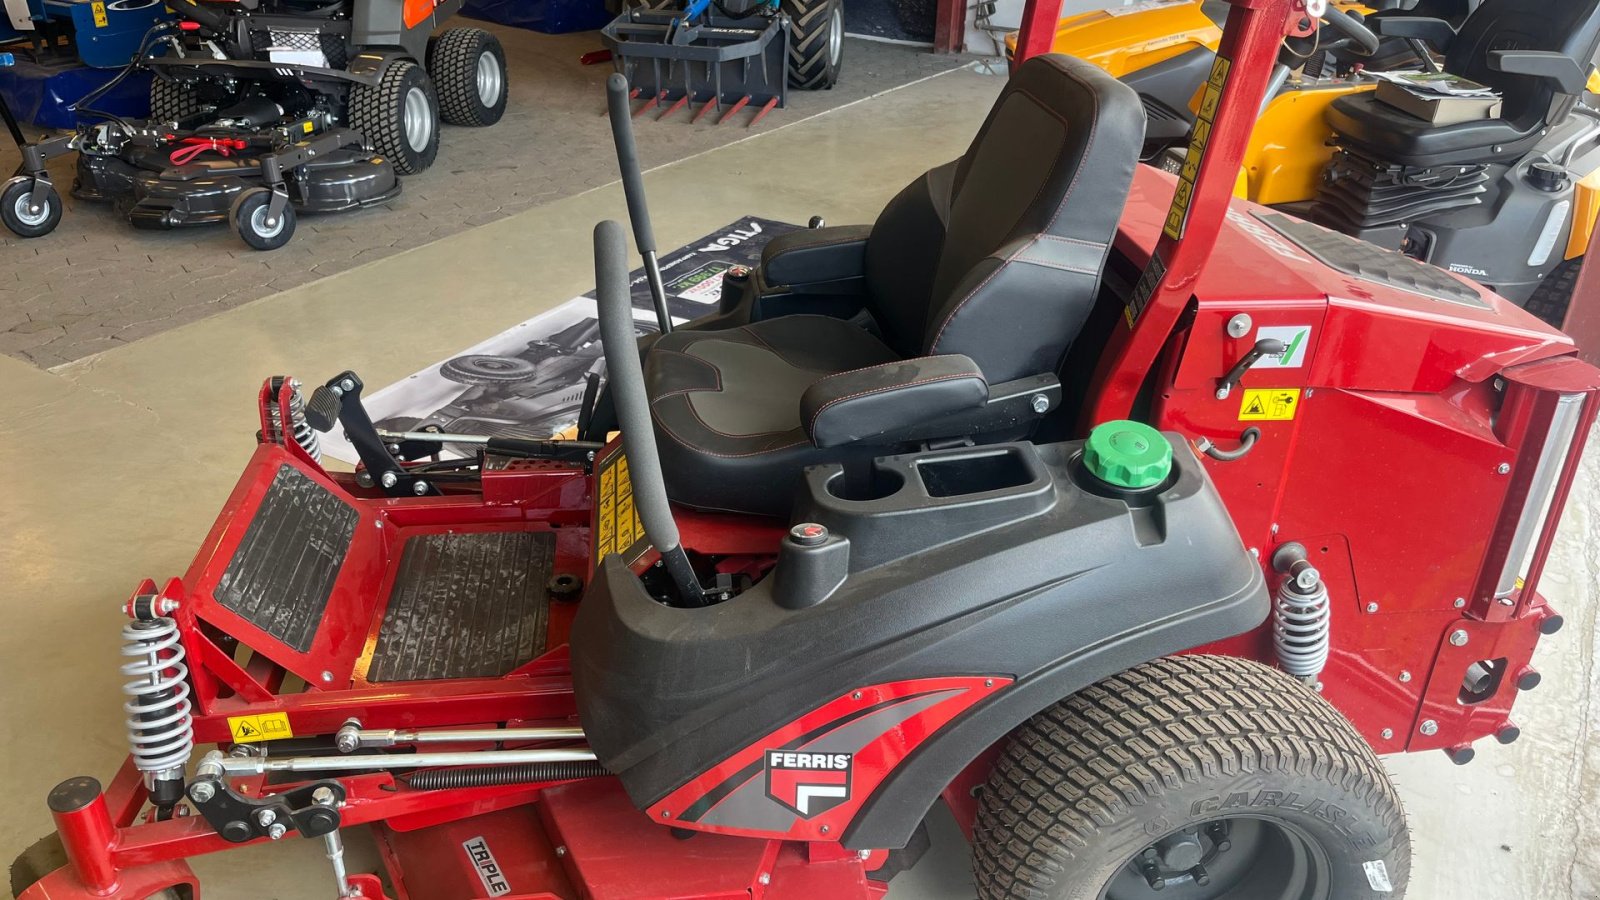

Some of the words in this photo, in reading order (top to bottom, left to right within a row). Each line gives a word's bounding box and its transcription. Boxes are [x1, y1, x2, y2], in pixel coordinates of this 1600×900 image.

[697, 222, 762, 252] STIGA
[1449, 266, 1487, 276] HONDA
[771, 752, 849, 769] FERRIS
[1190, 789, 1377, 850] CARLISLE
[470, 841, 508, 893] TRIPLE
